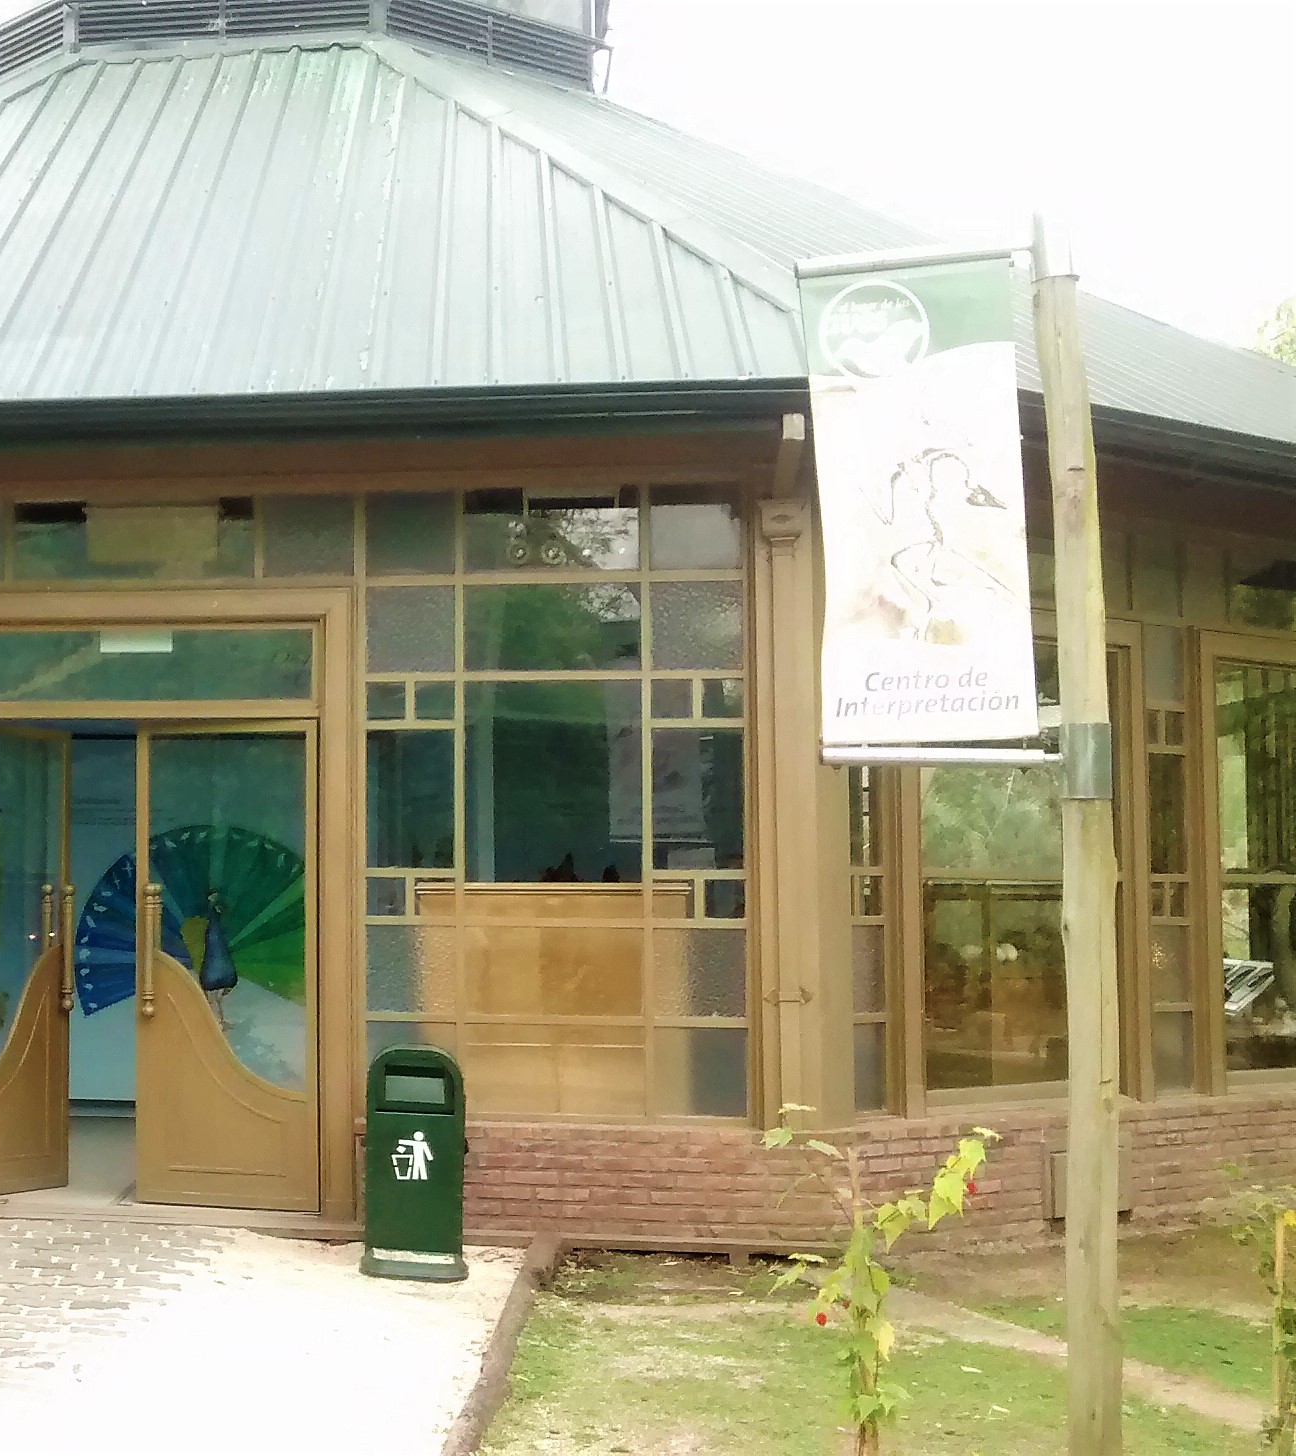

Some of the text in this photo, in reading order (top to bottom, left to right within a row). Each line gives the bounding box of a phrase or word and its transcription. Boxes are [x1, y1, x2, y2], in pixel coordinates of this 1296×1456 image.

[864, 665, 988, 692] Centro de
[835, 689, 1019, 721] Interpretación
